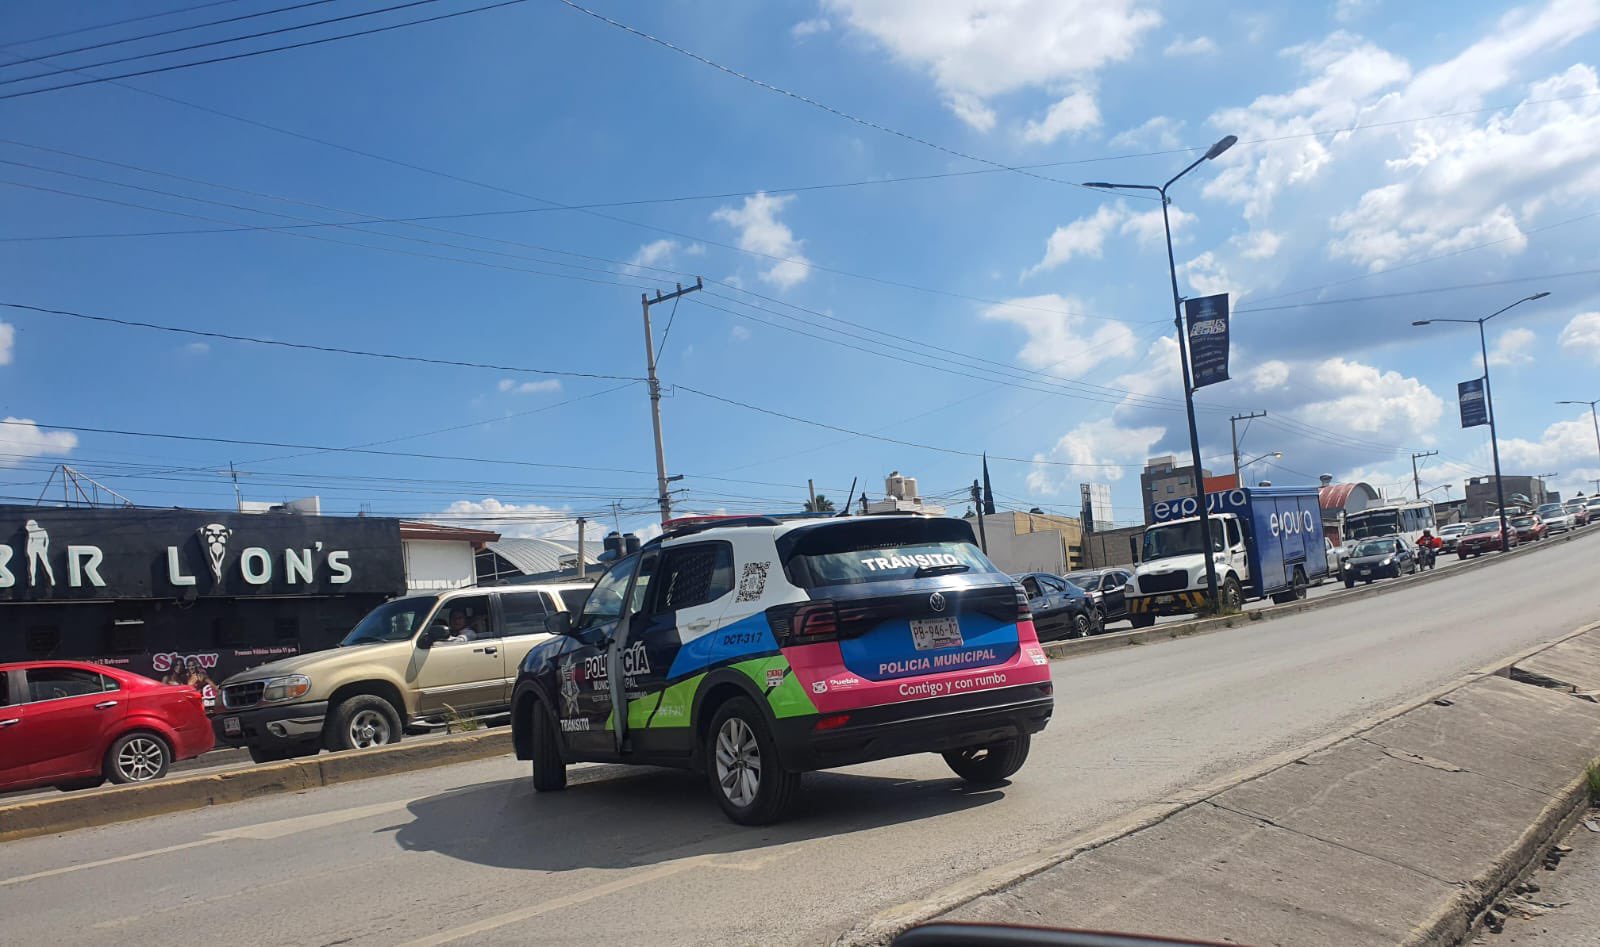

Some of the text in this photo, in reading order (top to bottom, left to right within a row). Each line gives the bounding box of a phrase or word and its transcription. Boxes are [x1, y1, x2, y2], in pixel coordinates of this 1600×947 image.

[862, 553, 959, 571] TRÁNSITO
[723, 631, 763, 646] DCT-317
[879, 648, 996, 675] POLICIA MUNICIPAL
[830, 677, 859, 686] Puebla
[899, 671, 1007, 697] Contigo y con rumbo
